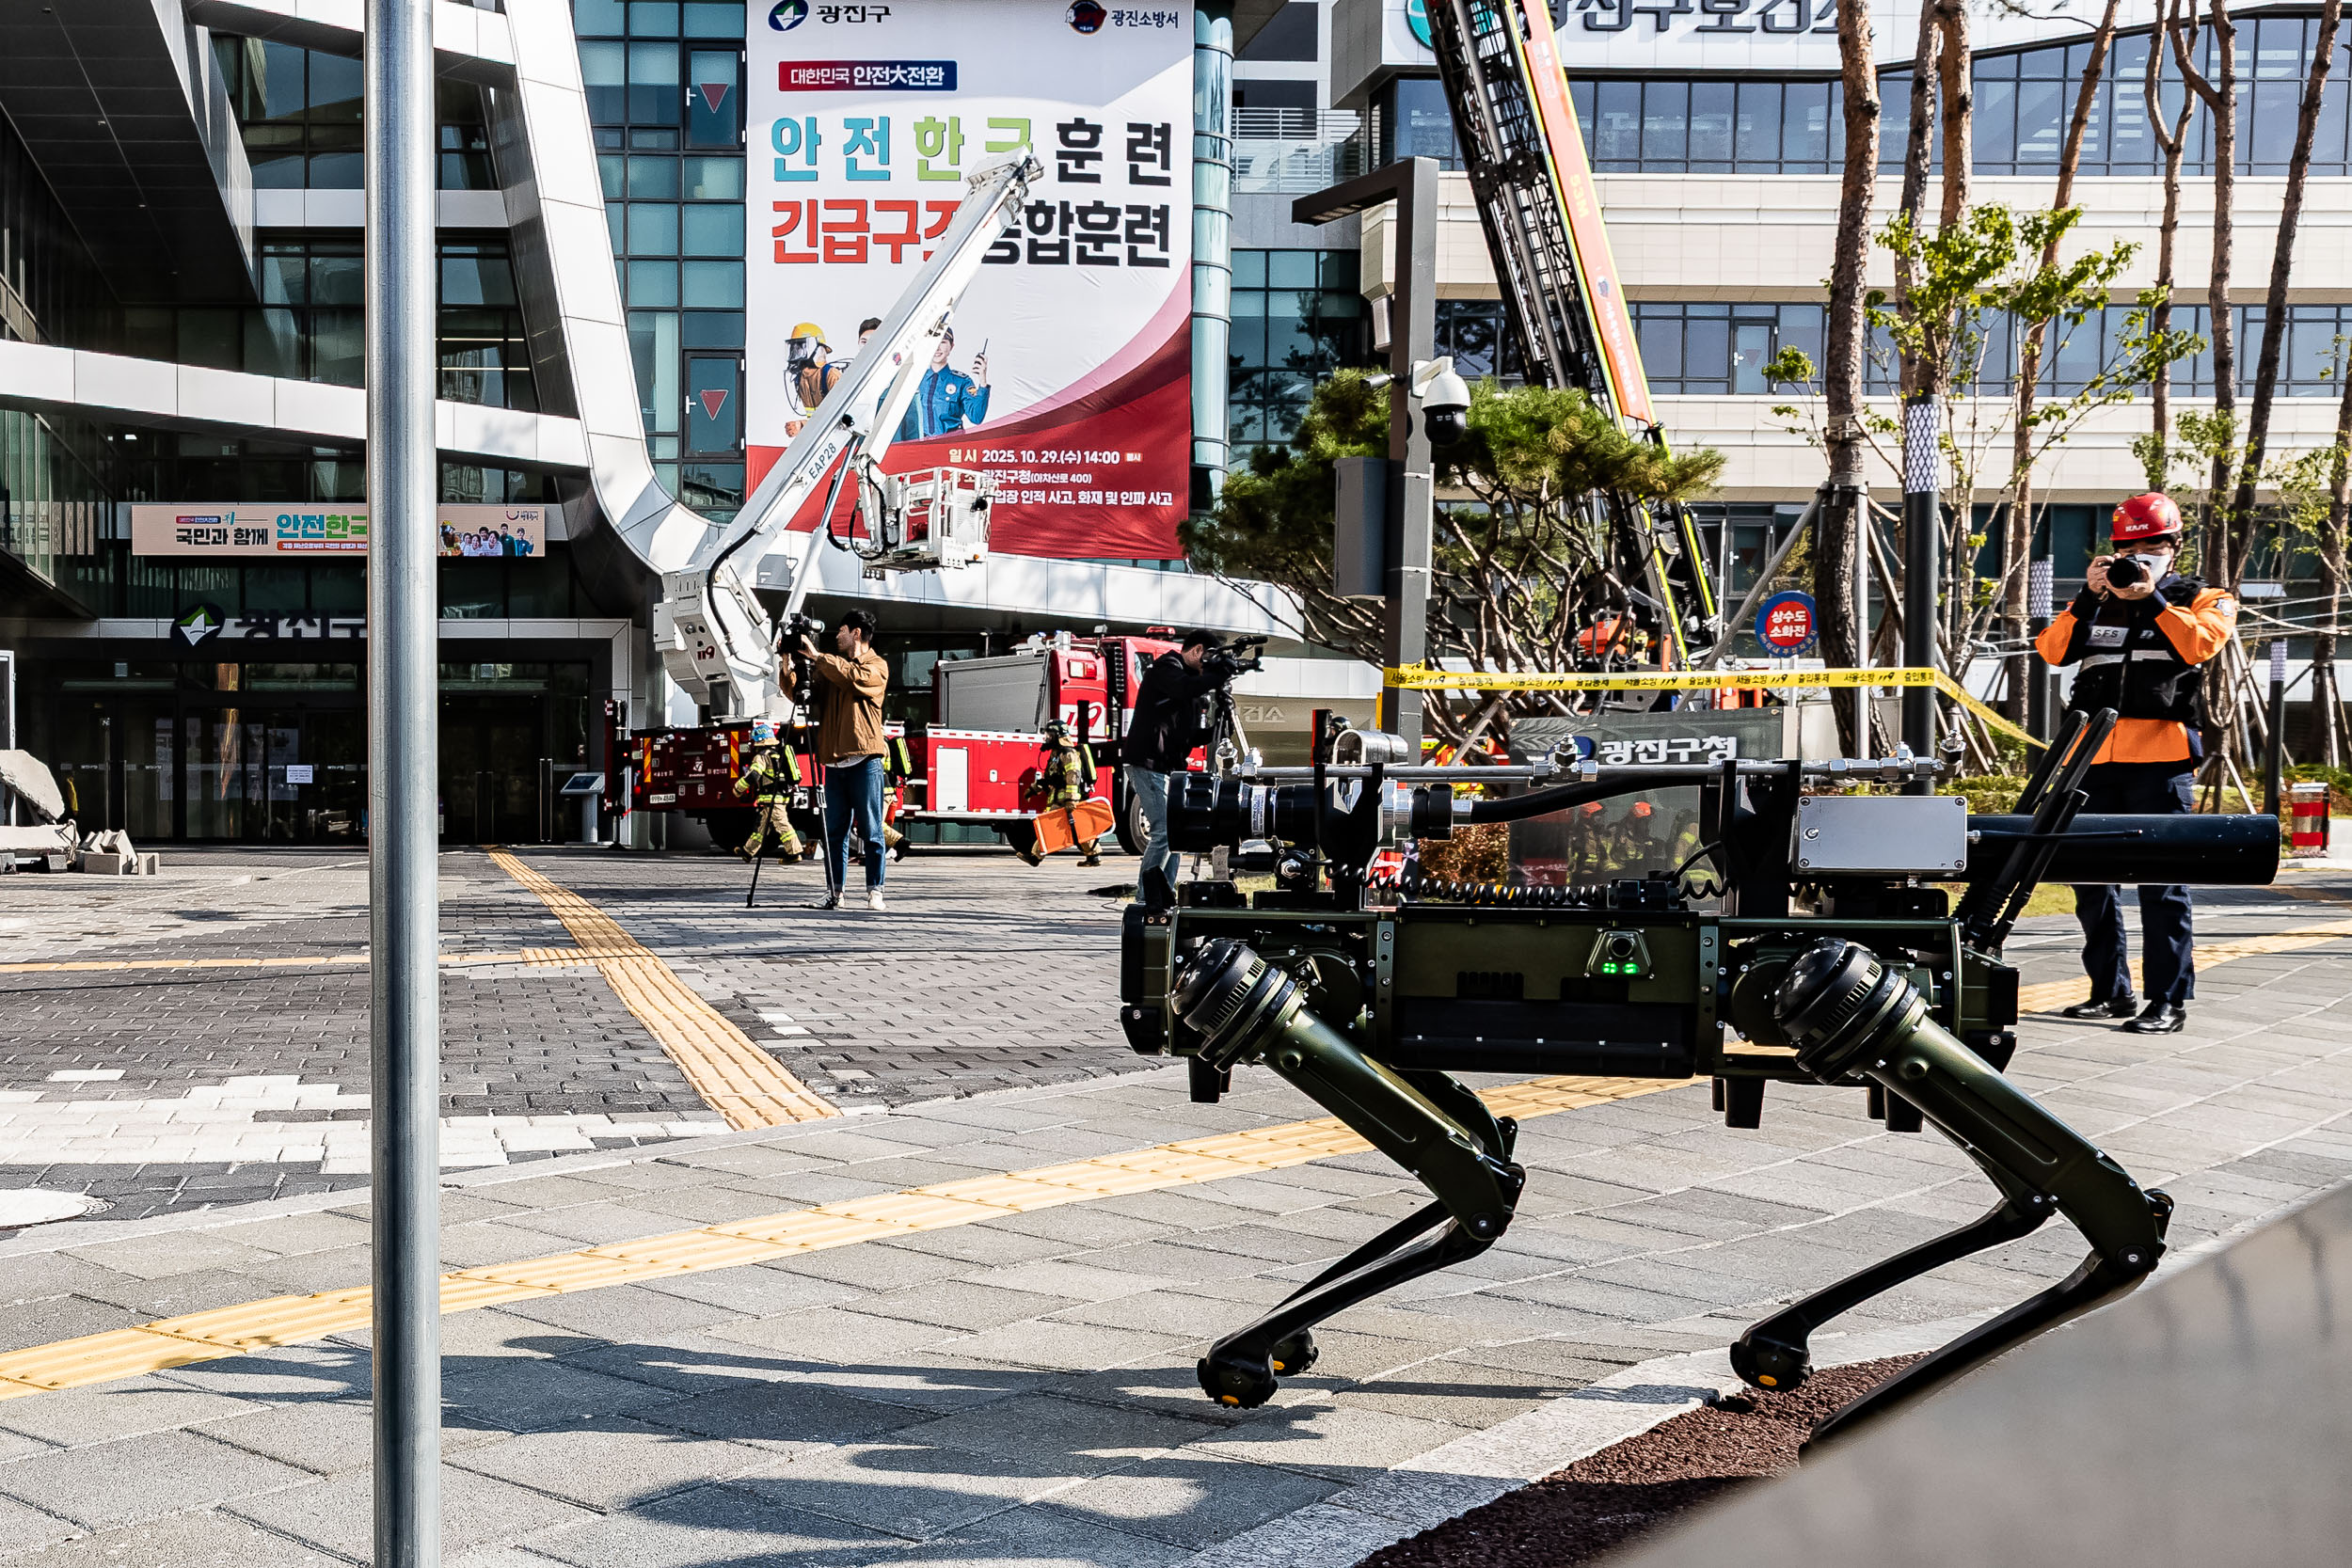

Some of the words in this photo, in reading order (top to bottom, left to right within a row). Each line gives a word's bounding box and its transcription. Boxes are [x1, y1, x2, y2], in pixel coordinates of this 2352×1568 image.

[817, 5, 892, 24] 광진구
[1110, 8, 1179, 29] 광진소방서
[790, 68, 850, 85] 대한민국
[853, 64, 945, 87] 안전大전환
[808, 442, 836, 480] EAP28
[981, 449, 1018, 463] 2025.
[1020, 450, 1039, 464] 10.
[1083, 451, 1120, 465] 14:00
[1070, 473, 1092, 484] 400)
[988, 489, 1019, 505] 업장
[1021, 491, 1046, 505] 인적
[1048, 491, 1076, 506] 사고,
[1077, 491, 1104, 505] 화재
[1104, 491, 1119, 505] 및
[1120, 491, 1146, 506] 인파
[1148, 491, 1173, 506] 사고
[176, 528, 229, 546] 국민과
[233, 528, 269, 546] 함께
[1771, 610, 1807, 624] 상수도
[1770, 625, 1806, 638] 소화전
[2093, 629, 2119, 638] SFS
[697, 645, 715, 660] 119
[1391, 673, 1424, 685] 서울소방
[1428, 674, 1446, 685] 119
[1546, 676, 1565, 687] 119
[1624, 676, 1658, 687] 서울소방
[1660, 675, 1678, 687] 119
[1736, 674, 1768, 685] 서울소방
[1770, 673, 1788, 684] 119
[1798, 673, 1830, 684] 출입통제
[1843, 673, 1875, 683] 서울소방
[1878, 672, 1896, 682] 119
[1066, 705, 1103, 730] 19
[1599, 736, 1738, 765] 광진구청
